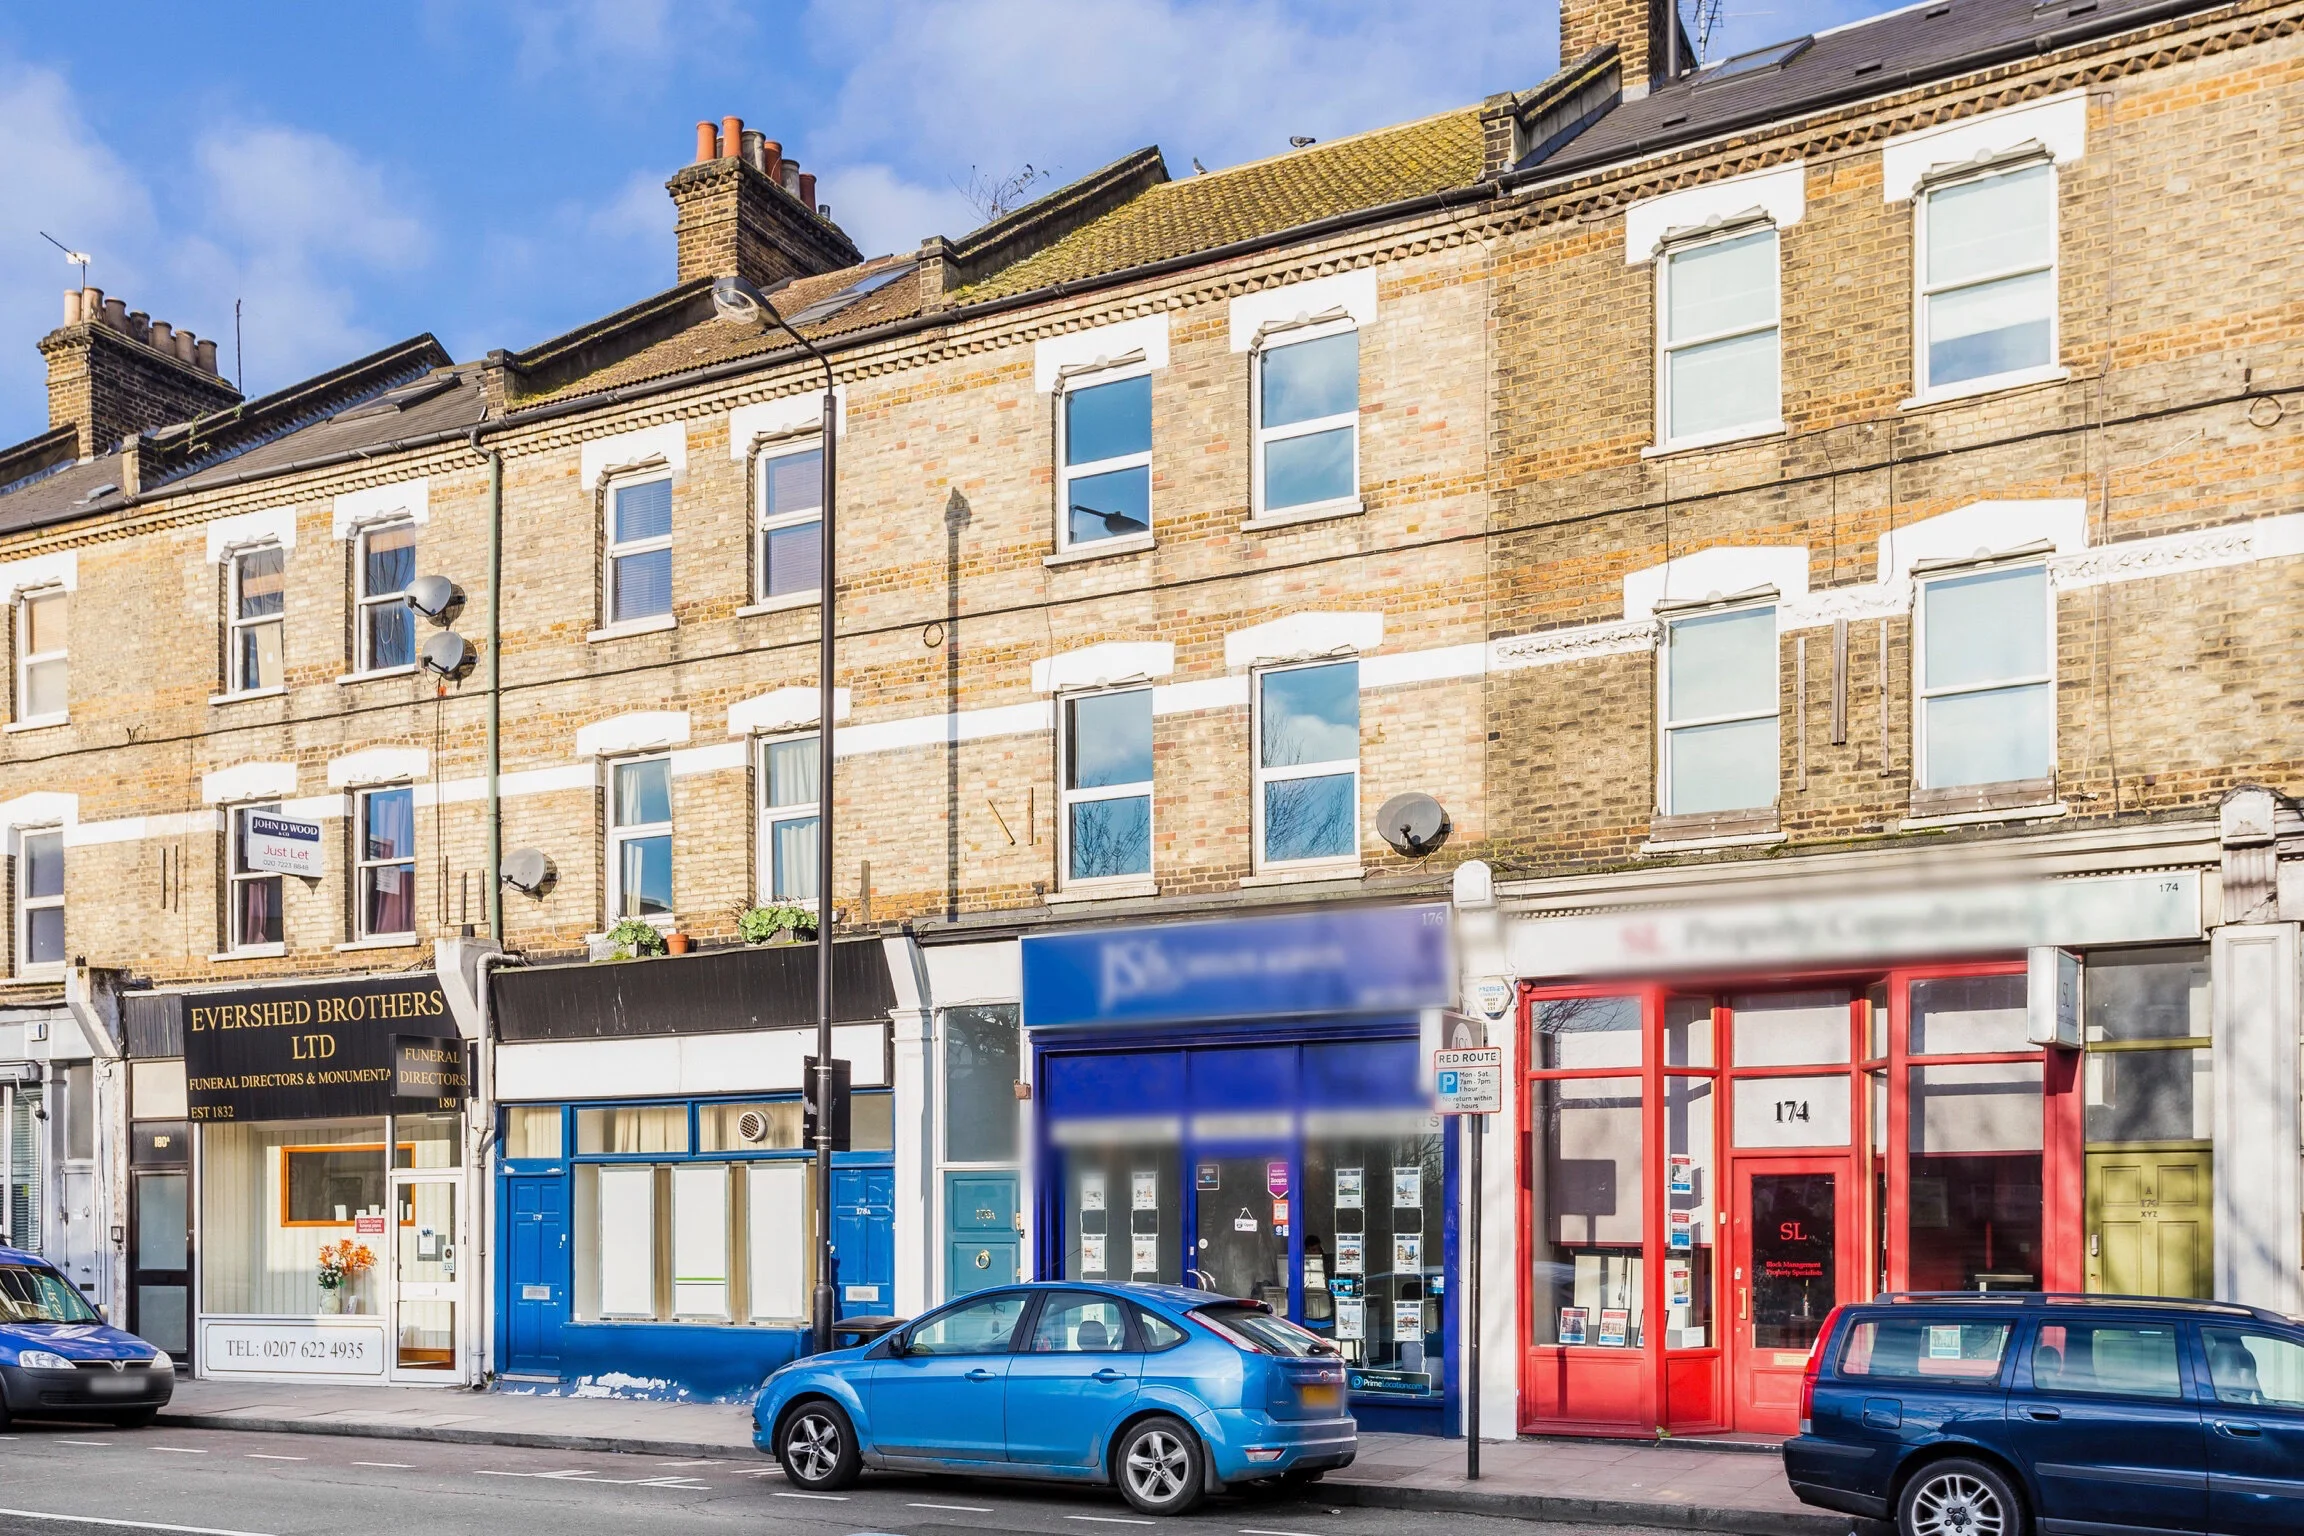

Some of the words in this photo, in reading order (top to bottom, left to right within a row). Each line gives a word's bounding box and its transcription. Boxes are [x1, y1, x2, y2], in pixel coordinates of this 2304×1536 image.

[254, 819, 279, 830] JOHN
[281, 823, 288, 831] D
[289, 824, 318, 835] WOOD
[264, 845, 287, 858] Just
[290, 848, 309, 860] Let
[2159, 883, 2179, 892] 174
[1422, 912, 1444, 926] 176
[191, 1000, 311, 1032] EVERSHED
[316, 990, 444, 1024] BROTHERS
[292, 1034, 336, 1060] LTD
[405, 1048, 460, 1063] FUNERAL
[1439, 1054, 1459, 1063] RED
[1462, 1052, 1497, 1062] ROUTE
[189, 1077, 239, 1091] FUNERAL
[241, 1073, 304, 1088] DIRECTORS
[306, 1074, 316, 1085] &
[400, 1070, 467, 1085] DIRECTORS
[1442, 1074, 1455, 1092] P
[191, 1107, 211, 1119] EST
[212, 1105, 234, 1118] 1832
[1773, 1100, 1810, 1123] 174
[1780, 1222, 1807, 1240] SL
[226, 1340, 259, 1357] TEL:
[263, 1340, 296, 1358] 0207
[301, 1341, 325, 1358] 622
[330, 1342, 364, 1359] 4935
